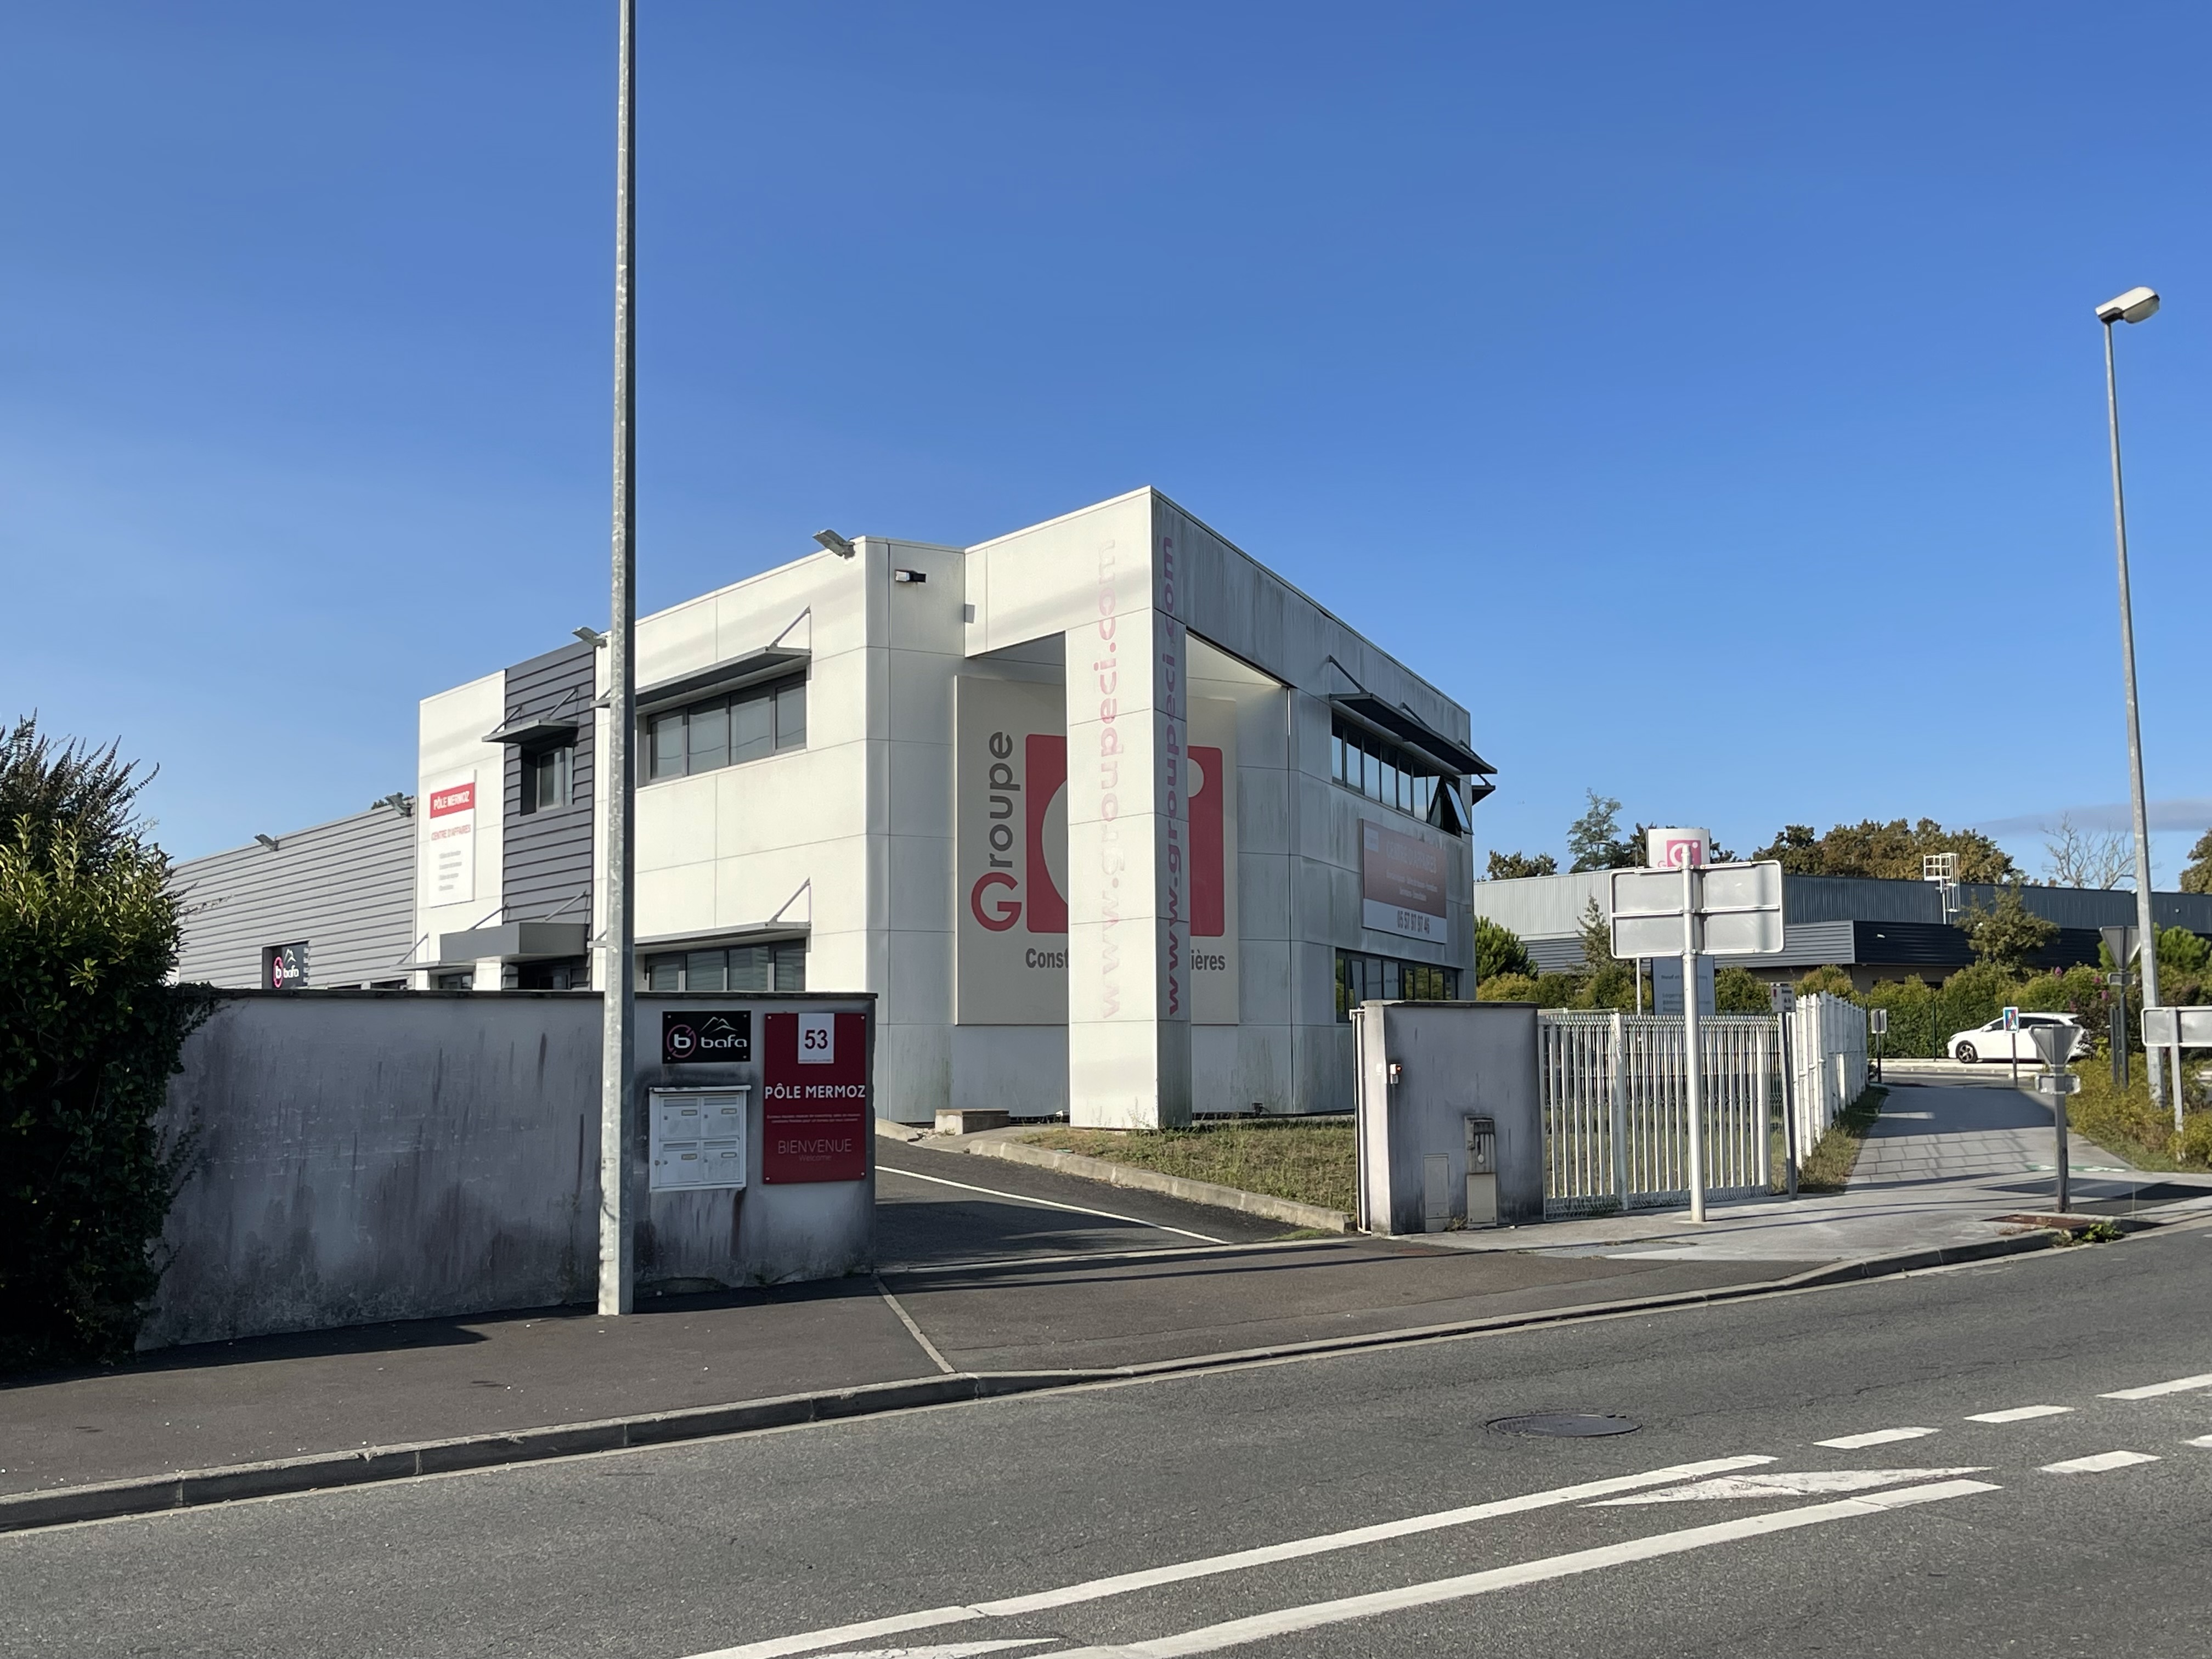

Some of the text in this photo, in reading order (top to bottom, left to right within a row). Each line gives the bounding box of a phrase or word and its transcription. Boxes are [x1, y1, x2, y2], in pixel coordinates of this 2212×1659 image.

[1163, 537, 1181, 1015] www.groupecicom
[971, 732, 1022, 932] Groupe
[701, 1034, 747, 1048] bafa
[804, 1029, 828, 1049] 53
[765, 1083, 865, 1099] PÔLE MERMOZ
[778, 1138, 852, 1154] BIENVENUE
